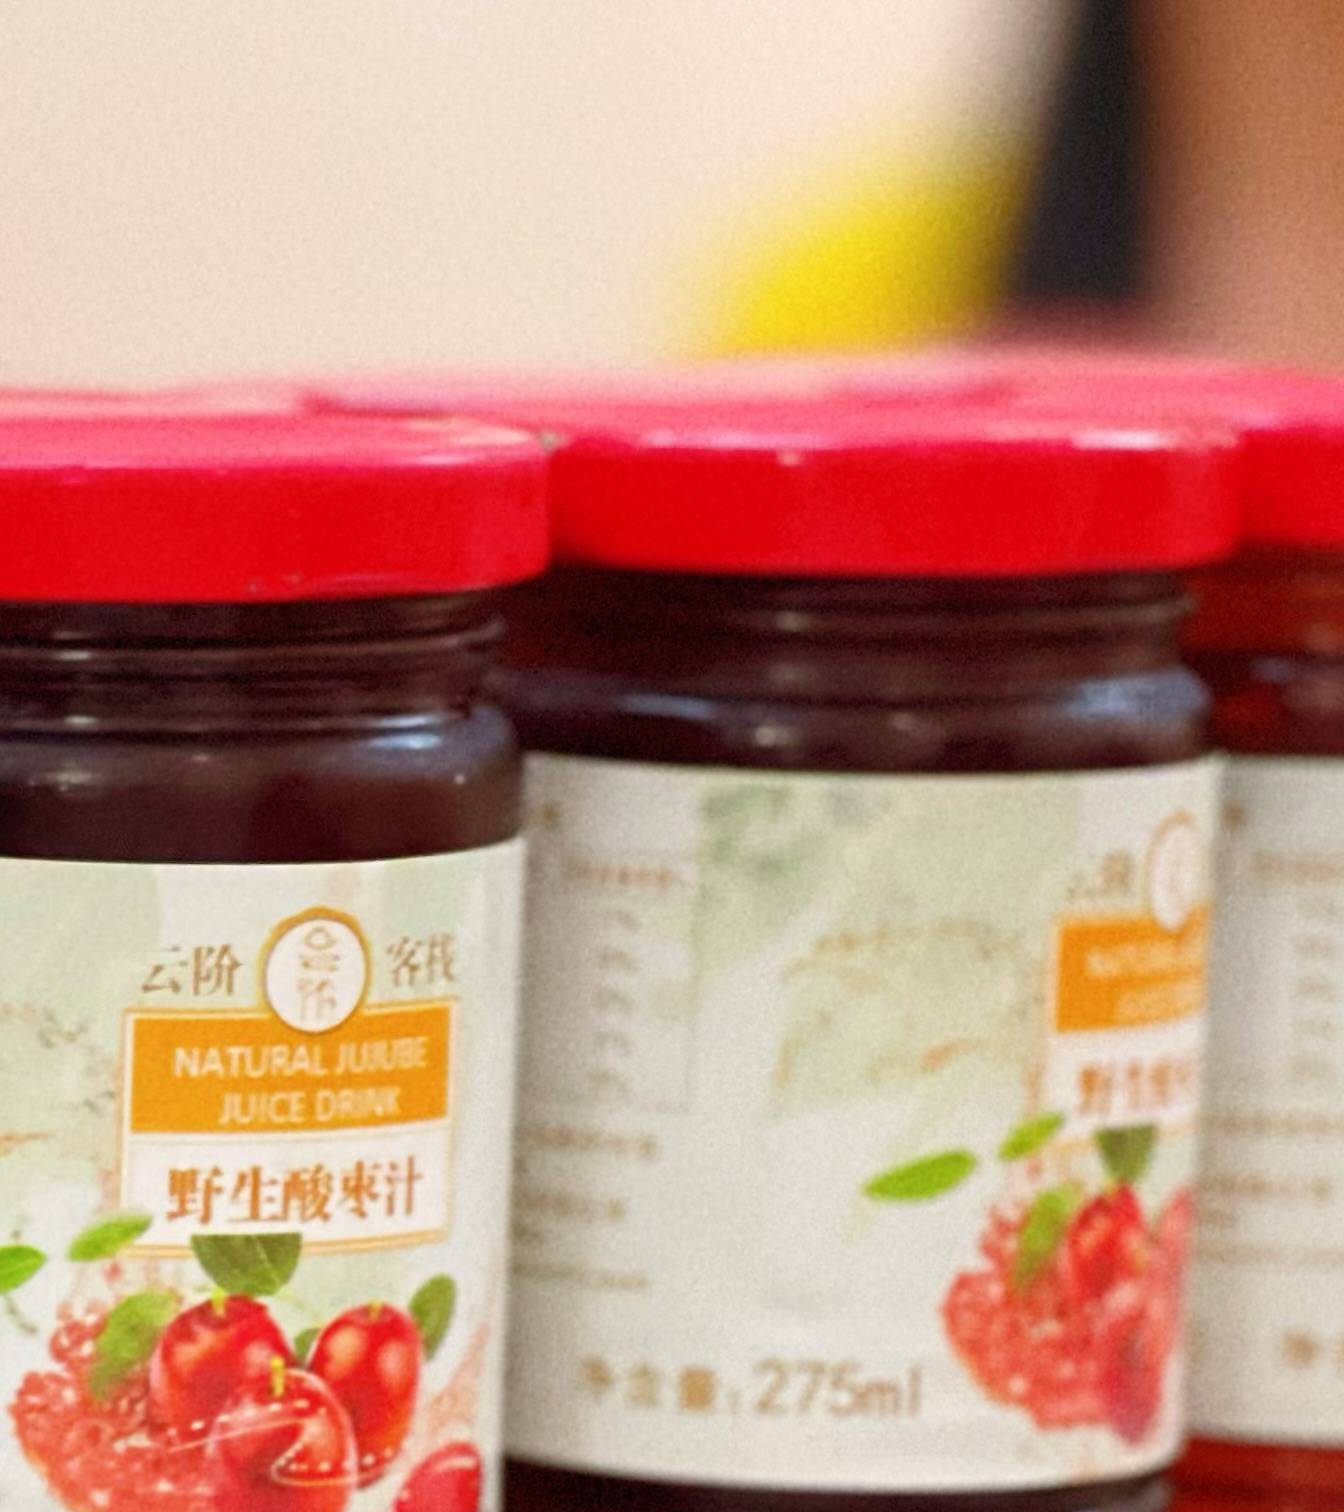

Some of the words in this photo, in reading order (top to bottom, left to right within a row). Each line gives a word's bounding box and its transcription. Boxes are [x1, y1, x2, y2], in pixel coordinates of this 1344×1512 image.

[140, 943, 245, 997] 云阶
[385, 932, 456, 989] 客栈
[173, 1044, 328, 1079] NATURAL
[334, 1036, 431, 1074] JUJUBE
[218, 1090, 307, 1126] JUICE
[315, 1086, 403, 1123] DRINK
[166, 1154, 424, 1226] 野生酸枣汁
